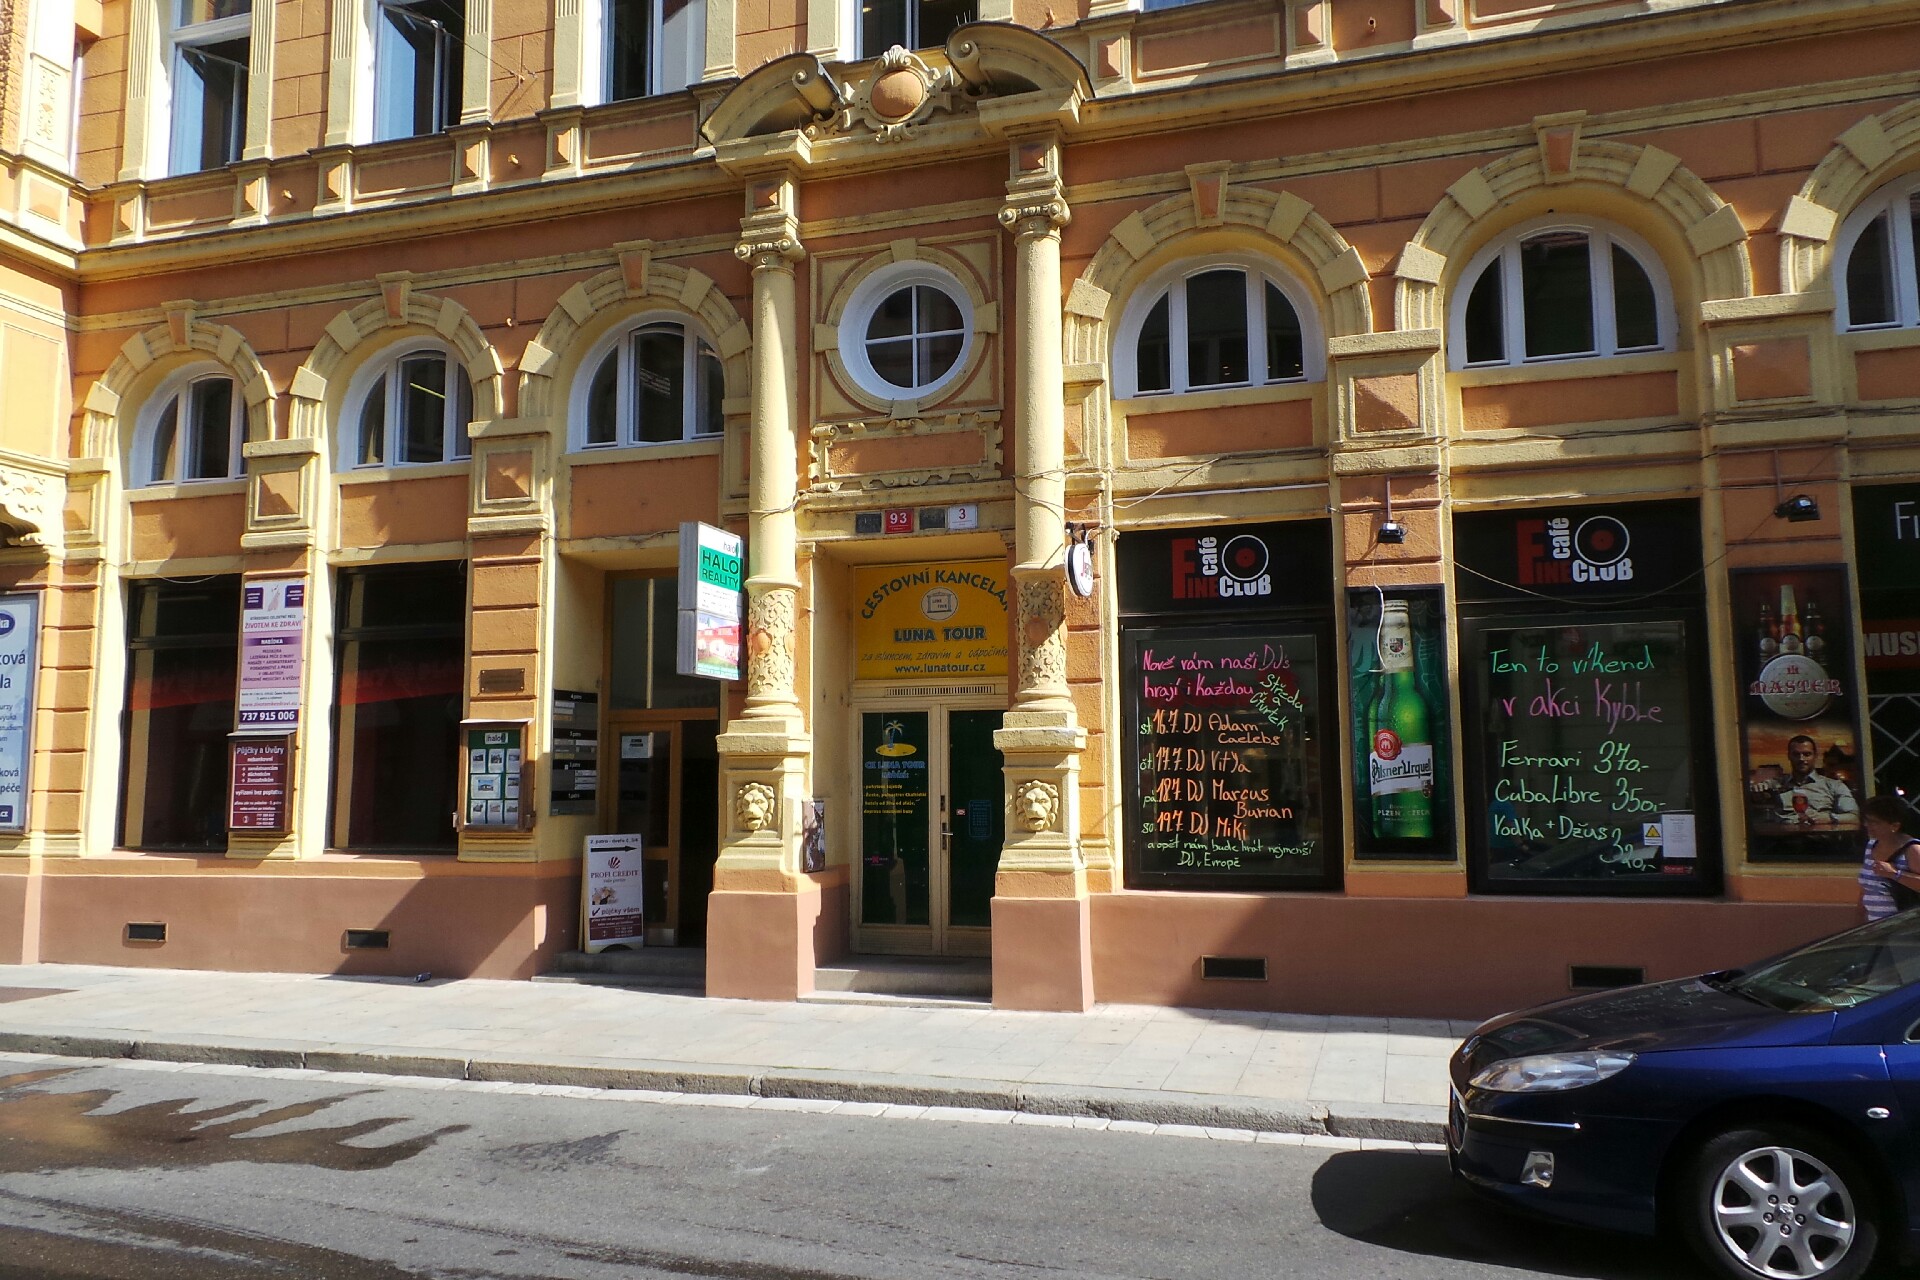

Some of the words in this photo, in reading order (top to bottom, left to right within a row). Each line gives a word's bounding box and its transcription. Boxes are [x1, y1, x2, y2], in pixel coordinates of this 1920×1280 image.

[889, 512, 908, 524] 93
[958, 508, 966, 520] 3
[1548, 517, 1571, 559] café
[702, 549, 739, 575] HALO
[1198, 536, 1219, 576] café
[702, 567, 739, 588] REALITY
[861, 567, 930, 620] CESTOVNÍ
[894, 627, 936, 643] LUNA
[943, 626, 987, 642] TOUR
[894, 663, 986, 674] www.lunatour.cz
[1221, 651, 1258, 670] naši
[1490, 648, 1527, 674] Ten
[1537, 644, 1559, 673] to
[1144, 675, 1182, 702] hrají
[1186, 682, 1191, 696] i
[1749, 678, 1844, 697] MASTER
[242, 712, 258, 721] 737
[259, 711, 276, 720] 915
[277, 710, 295, 720] 006
[1183, 712, 1202, 734] DJ
[1208, 713, 1259, 733] Adam
[1186, 749, 1206, 772] DJ
[1501, 739, 1582, 768] Ferrari
[1371, 758, 1403, 785] Pilsner
[1187, 779, 1204, 802] DJ
[1212, 779, 1270, 802] Marcus
[1494, 778, 1550, 803] Cuba
[1552, 774, 1602, 803] Libre
[1233, 801, 1293, 819] Burian
[1189, 811, 1209, 836] DJ
[1211, 839, 1239, 852] bude
[1177, 851, 1195, 867] DJ
